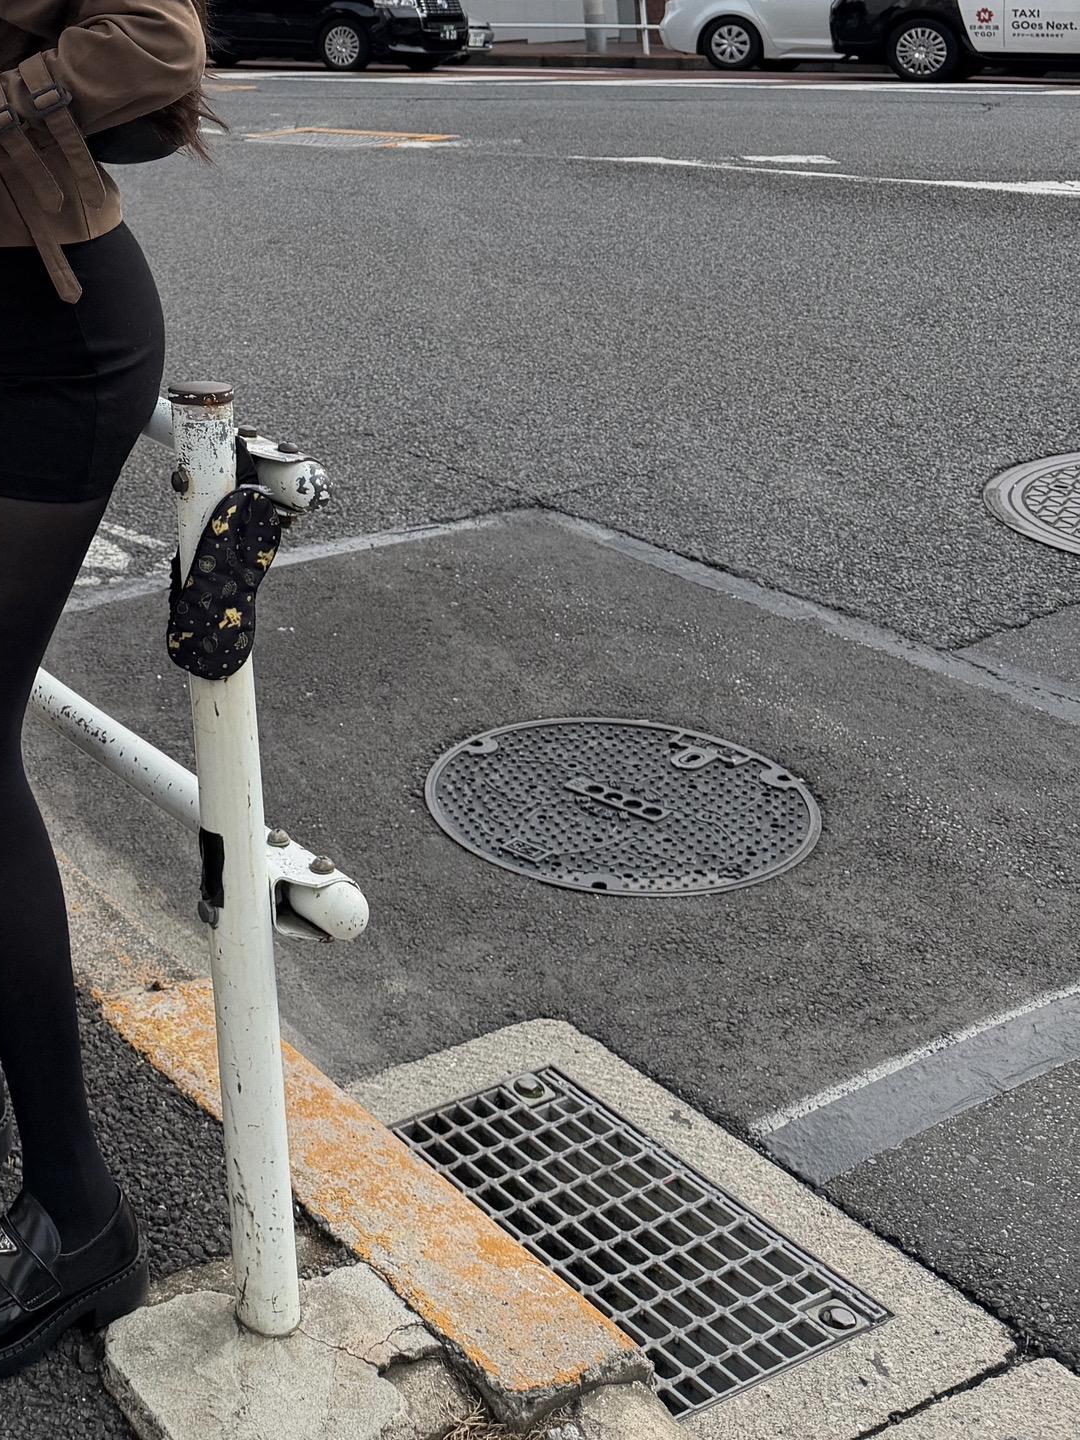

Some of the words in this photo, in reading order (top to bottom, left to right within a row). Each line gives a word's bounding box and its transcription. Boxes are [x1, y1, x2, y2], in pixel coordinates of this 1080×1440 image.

[1012, 9, 1040, 18] TAXI
[1011, 20, 1043, 30] GOes
[1046, 21, 1078, 30] Next.
